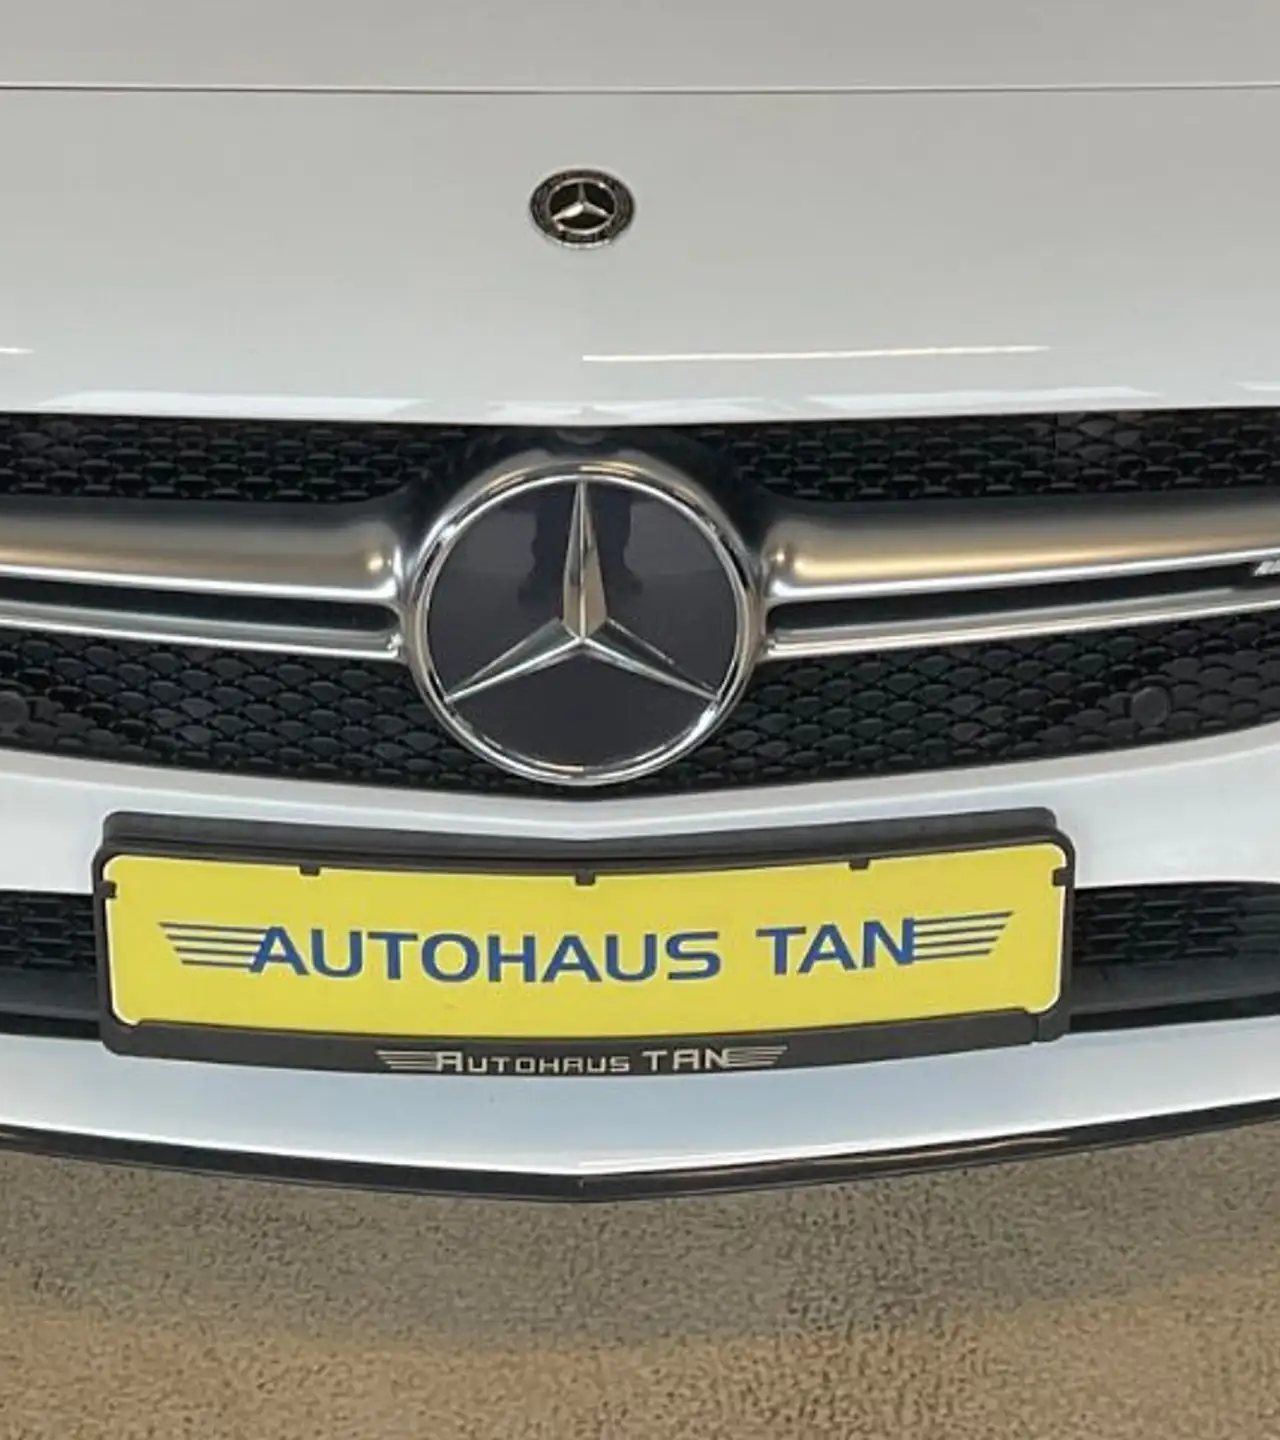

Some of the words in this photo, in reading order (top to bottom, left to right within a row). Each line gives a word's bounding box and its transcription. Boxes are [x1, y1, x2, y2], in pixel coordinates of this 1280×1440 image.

[249, 925, 722, 984] AUTOHAUS
[755, 916, 916, 976] TAN
[435, 1050, 631, 1074] AUTOHAUS
[642, 1047, 732, 1073] TAN
